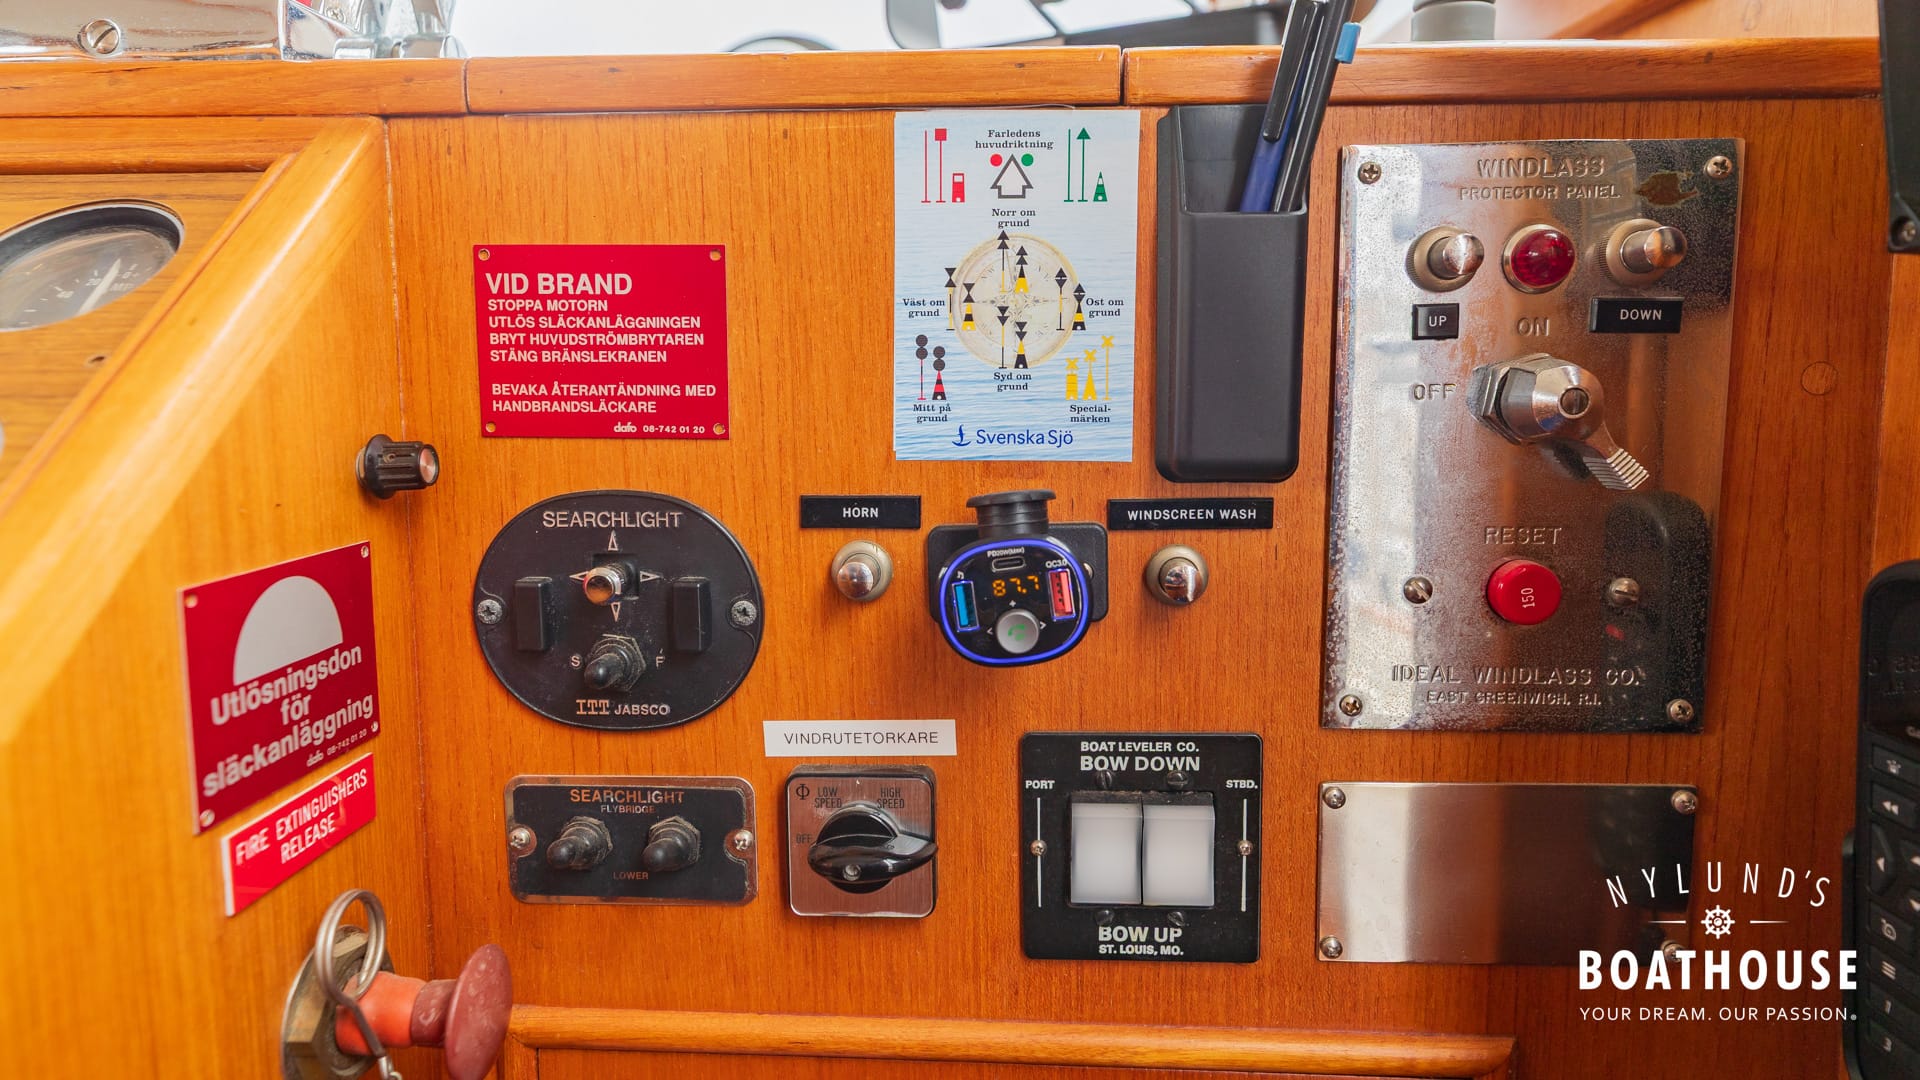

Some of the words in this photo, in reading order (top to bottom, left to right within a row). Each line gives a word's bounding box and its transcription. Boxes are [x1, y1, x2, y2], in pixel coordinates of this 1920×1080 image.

[988, 130, 1040, 138] Farledens
[975, 140, 1054, 150] huvudriktning
[1478, 158, 1605, 178] WINDLASS
[1460, 184, 1560, 200] PROTECTOR
[1567, 184, 1621, 200] PANEL
[992, 208, 1016, 217] Norr
[998, 219, 1030, 229] grund
[486, 273, 528, 294] VID
[537, 273, 632, 294] BRAND
[488, 300, 542, 311] STOPPA
[547, 300, 608, 311] MOTORN
[903, 298, 928, 306] Väst
[1086, 298, 1107, 306] Ost
[908, 309, 940, 318] grund
[1089, 309, 1120, 318] grund
[1620, 309, 1662, 320] DOWN
[489, 314, 535, 328] UTLÖS
[539, 314, 700, 328] SLÄCKANLÄGGNINGEN
[1428, 315, 1447, 327] UP
[1516, 318, 1549, 337] ON
[490, 333, 525, 345] BRYT
[530, 332, 704, 345] HUVUDSTRÖMBRYTAREN
[490, 348, 538, 362] STÄNG
[542, 348, 666, 362] BRÄNSLEKRANEN
[994, 372, 1012, 382] Syd
[492, 384, 548, 395] BEVAKA
[552, 381, 680, 396] ÅTERANTÄNDNING
[685, 385, 716, 396] MED
[997, 382, 1028, 392] grund
[1413, 383, 1457, 400] OFF
[493, 399, 656, 413] HANDBRANDSLÄCKARE
[938, 403, 951, 414] på
[1070, 404, 1111, 414] Special-
[917, 414, 948, 423] grund
[614, 422, 636, 433] dafo
[643, 425, 676, 434] 08-742
[693, 426, 705, 434] 20
[976, 429, 1044, 444] Svenska
[1048, 429, 1073, 448] Sjö
[843, 507, 878, 518] HORN
[1128, 508, 1213, 521] WINDSCREEN
[1220, 508, 1256, 520] WASH
[543, 511, 682, 528] SEARCHLIGHT
[1485, 527, 1563, 545] RESET
[992, 575, 1040, 596] 87.7
[1521, 588, 1535, 608] 150
[571, 656, 580, 667] S
[656, 656, 665, 668] F
[1392, 664, 1461, 684] IDEAL
[1473, 666, 1592, 685] WINDLASS
[1606, 668, 1640, 686] CO.
[210, 646, 362, 725] Utlösningsdon
[1427, 691, 1468, 704] EAST
[281, 693, 311, 725] för
[576, 699, 609, 715] ITT
[614, 704, 670, 716] JABSCO
[784, 731, 938, 745] VINDRUTETORKARE
[203, 694, 373, 797] släckanläggning
[1081, 742, 1115, 751] BOAT
[1119, 742, 1171, 752] LEVELER
[1177, 742, 1199, 752] CO.
[1080, 756, 1129, 771] BOW
[1135, 756, 1200, 771] DOWN
[1026, 780, 1054, 789] PORT
[1226, 780, 1258, 789] STBD.
[570, 789, 685, 804] SEARCHLIGHT
[818, 787, 838, 797] LOW
[880, 787, 900, 797] HIGH
[601, 805, 656, 813] FLYBRIDGE
[814, 798, 842, 808] SPEED
[877, 798, 904, 809] SPEED
[236, 827, 270, 866] FIRE
[276, 769, 367, 841] EXTINGUISHERS
[281, 812, 336, 864] RELEASE
[796, 834, 812, 843] OFF
[1099, 926, 1149, 941] BOW
[1154, 927, 1182, 942] UP
[1099, 945, 1116, 954] ST.
[1120, 945, 1157, 955] LOUIS,
[1160, 946, 1184, 955] MO.
